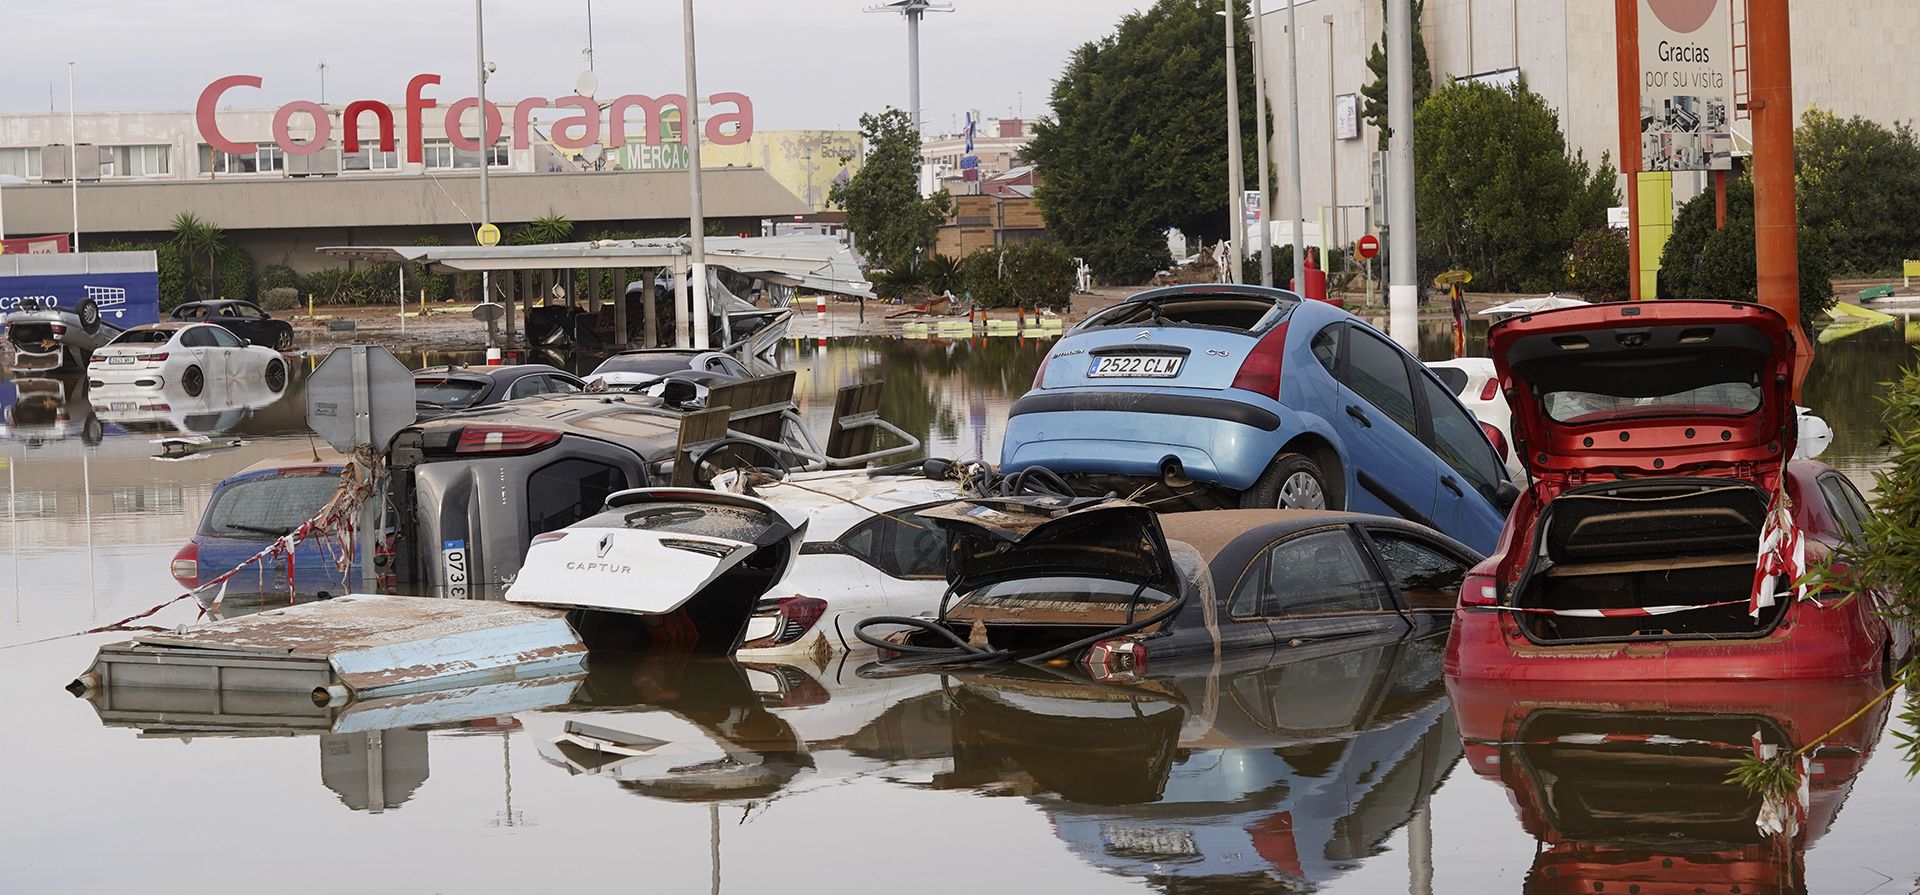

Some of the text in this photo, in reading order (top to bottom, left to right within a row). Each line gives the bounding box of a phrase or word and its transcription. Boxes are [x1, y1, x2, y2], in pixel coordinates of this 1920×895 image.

[1658, 40, 1710, 63] Gracias
[1645, 67, 1723, 92] por su visita
[195, 73, 754, 163] Conforama
[1099, 358, 1178, 373] 2522 CLM
[566, 561, 633, 575] CAPTUR
